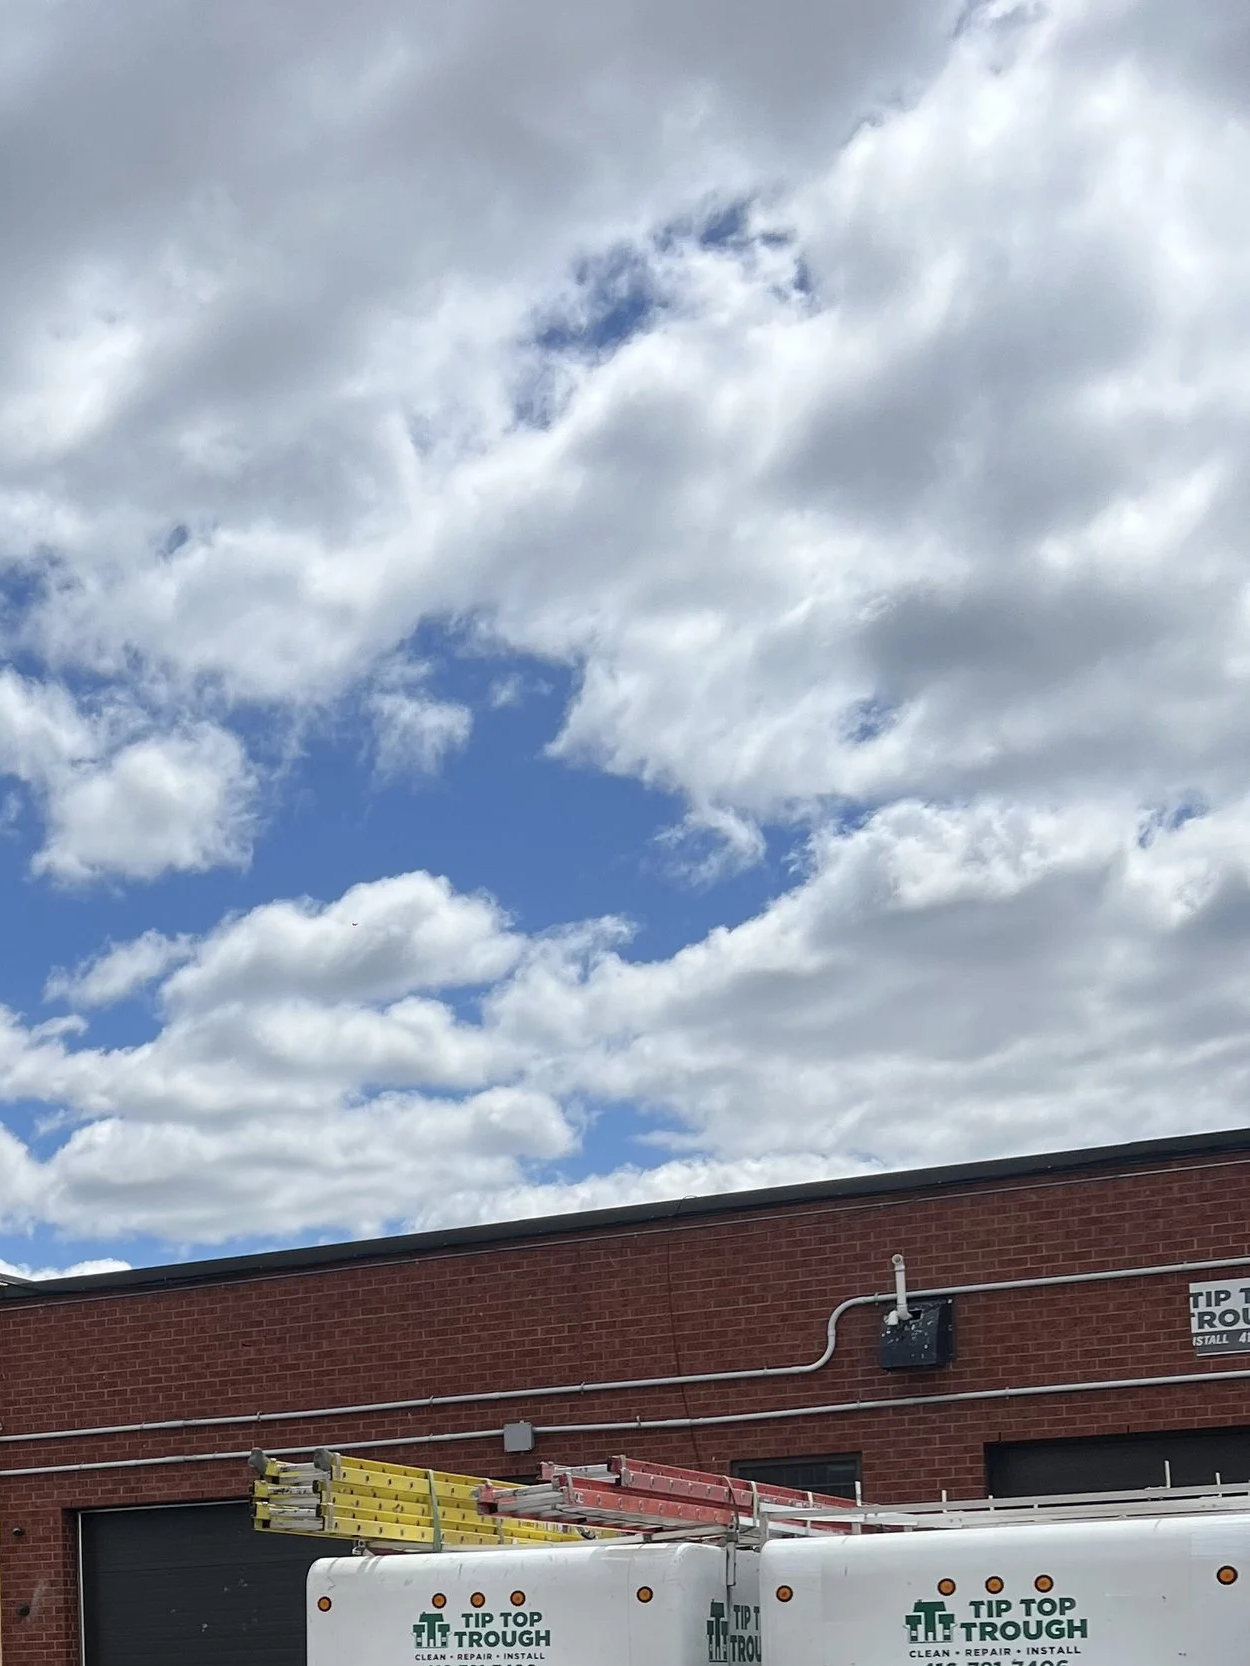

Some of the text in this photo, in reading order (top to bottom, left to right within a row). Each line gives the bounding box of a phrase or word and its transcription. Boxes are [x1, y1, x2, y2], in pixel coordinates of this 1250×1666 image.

[1190, 1290, 1231, 1308] TIP
[733, 1604, 751, 1630] TIP
[969, 1597, 1076, 1618] TIP TOP
[461, 1611, 542, 1628] TIP TOP
[454, 1629, 551, 1648] TROUGH
[960, 1618, 1088, 1642] TROUGH
[415, 1653, 446, 1661] CLEAN
[503, 1652, 545, 1660] INSTALL
[729, 1635, 762, 1662] TROU
[909, 1646, 1081, 1658] CLEAN REPAIR INSTALL
